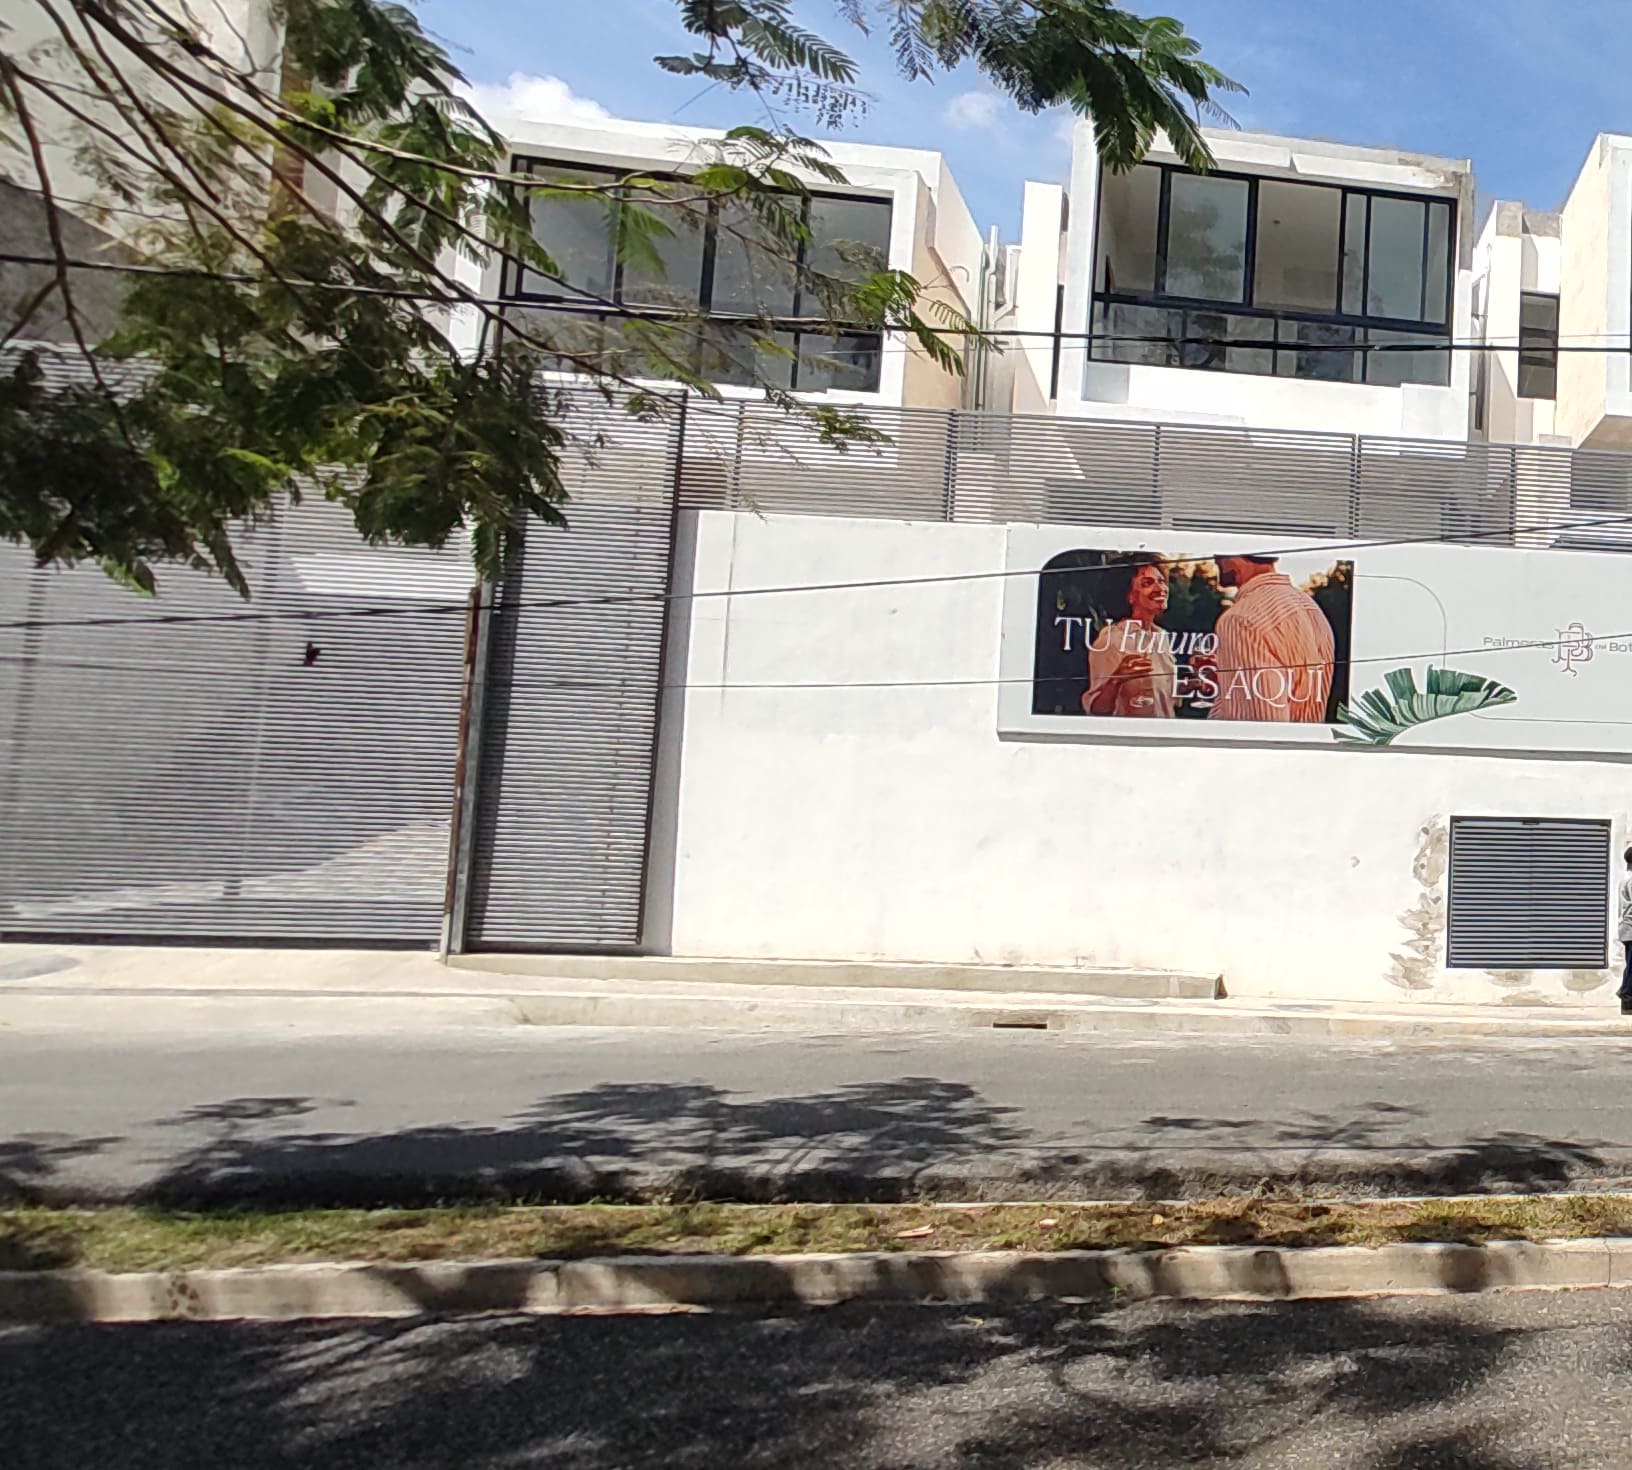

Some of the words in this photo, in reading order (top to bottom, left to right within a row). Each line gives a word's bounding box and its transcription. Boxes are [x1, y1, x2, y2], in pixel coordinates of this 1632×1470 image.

[1054, 615, 1114, 652] TU
[1119, 618, 1219, 656] Futuro
[1171, 664, 1219, 699] ES
